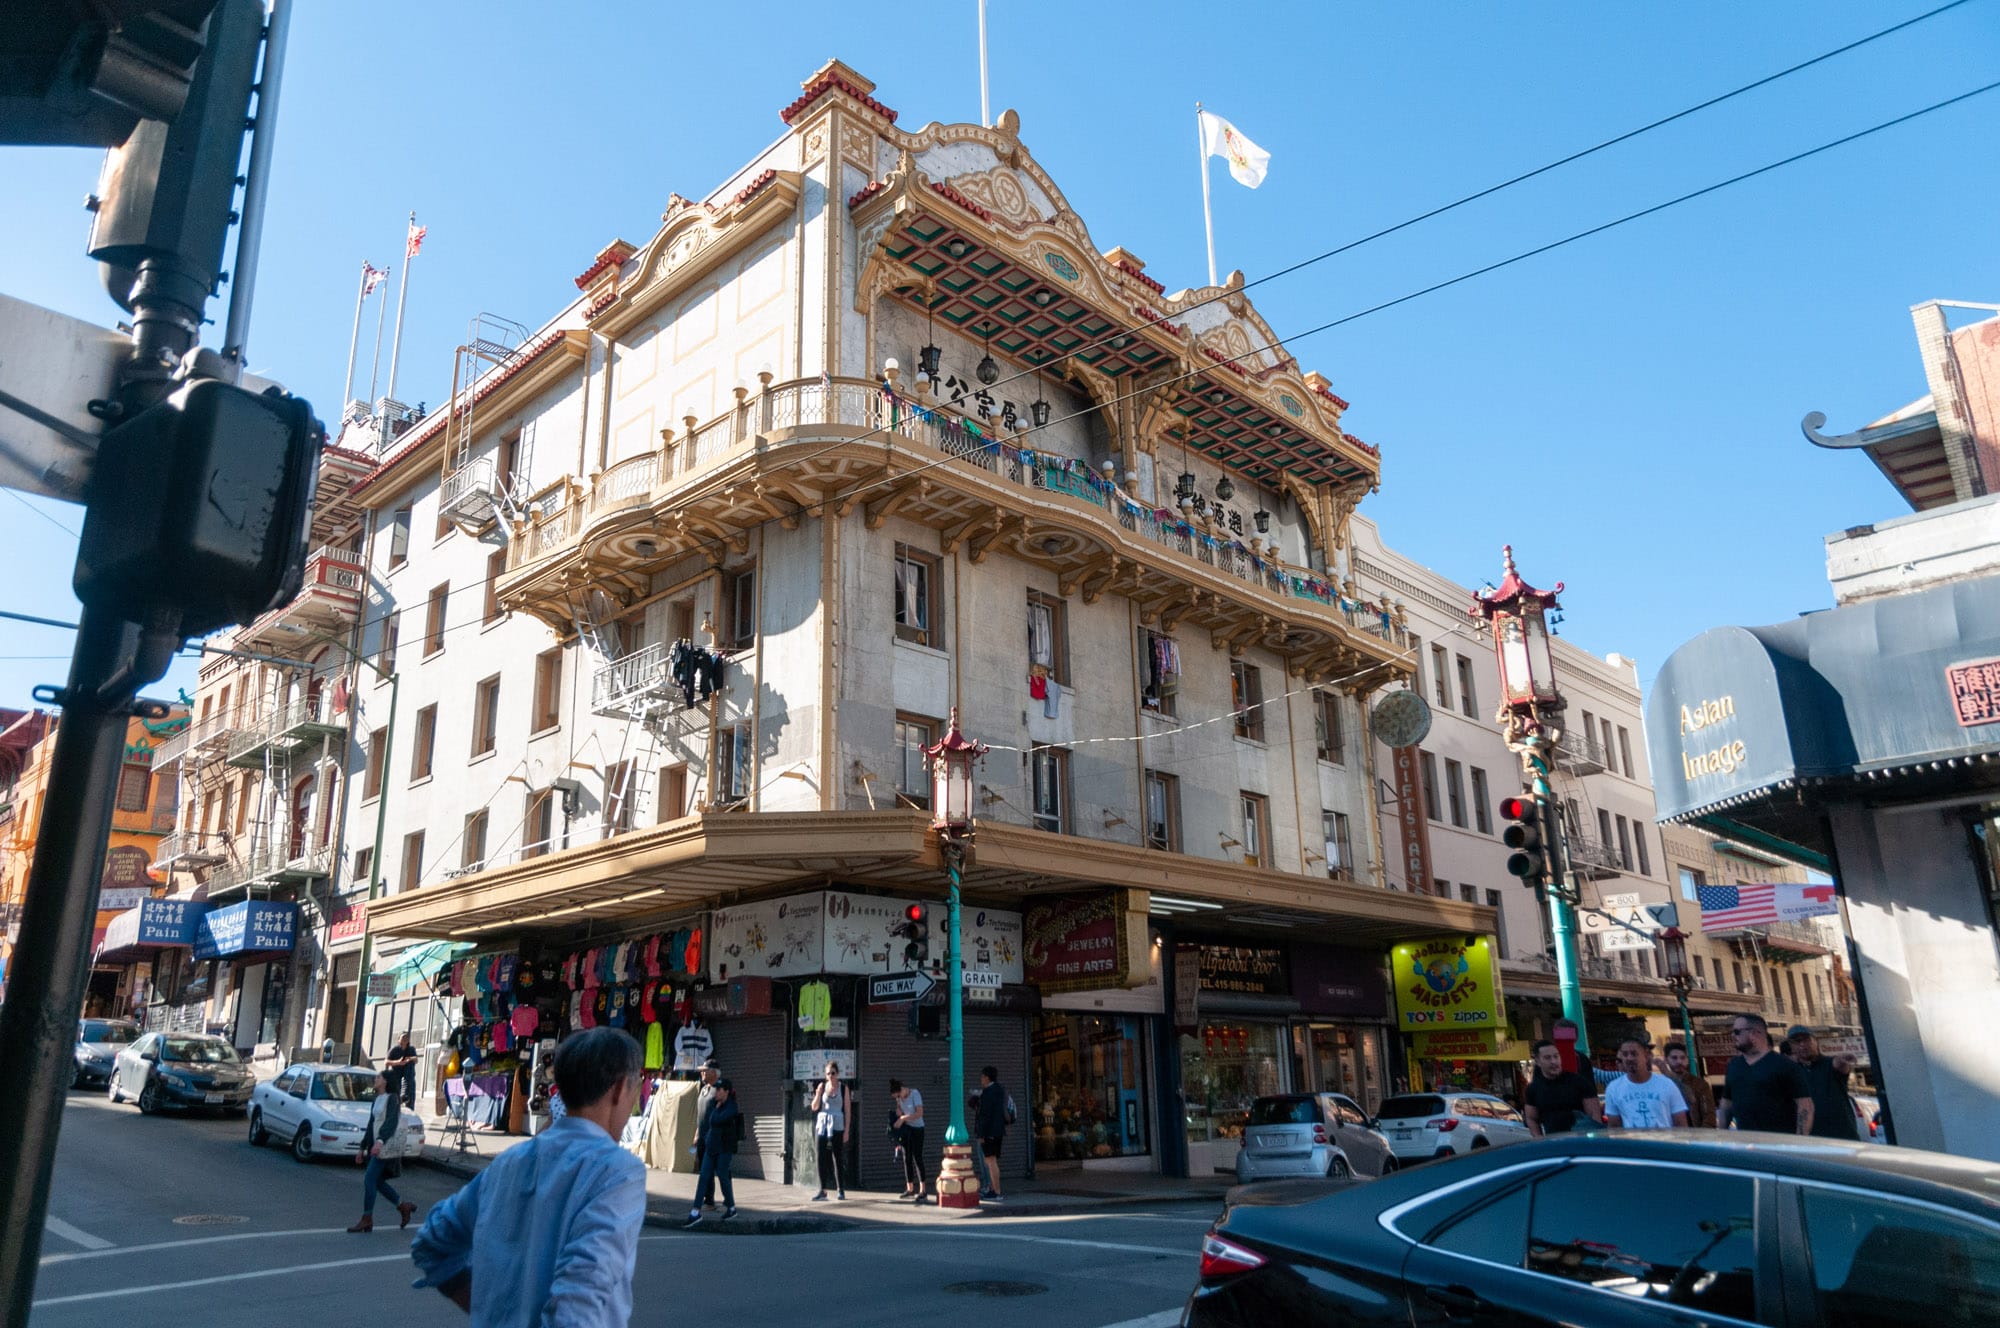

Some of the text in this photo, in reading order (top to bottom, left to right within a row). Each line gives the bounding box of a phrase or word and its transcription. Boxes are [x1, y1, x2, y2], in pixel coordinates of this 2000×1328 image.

[1681, 696, 1734, 737] Asian
[1682, 740, 1746, 781] Image
[1400, 756, 1415, 825] GIFTS
[1585, 907, 1665, 928] CLAY
[145, 926, 180, 938] Pain
[255, 935, 289, 947] Pain
[1067, 937, 1115, 952] JEWELRY
[1411, 942, 1467, 961] WORLD OF
[1056, 958, 1114, 975] FINE ARTS
[876, 979, 915, 994] ONE WAY
[965, 973, 1000, 985] GRANT
[1410, 977, 1477, 1008] MAGNETS
[1406, 1010, 1488, 1023] TOYS zippo
[1623, 1092, 1660, 1102] TACOMA
